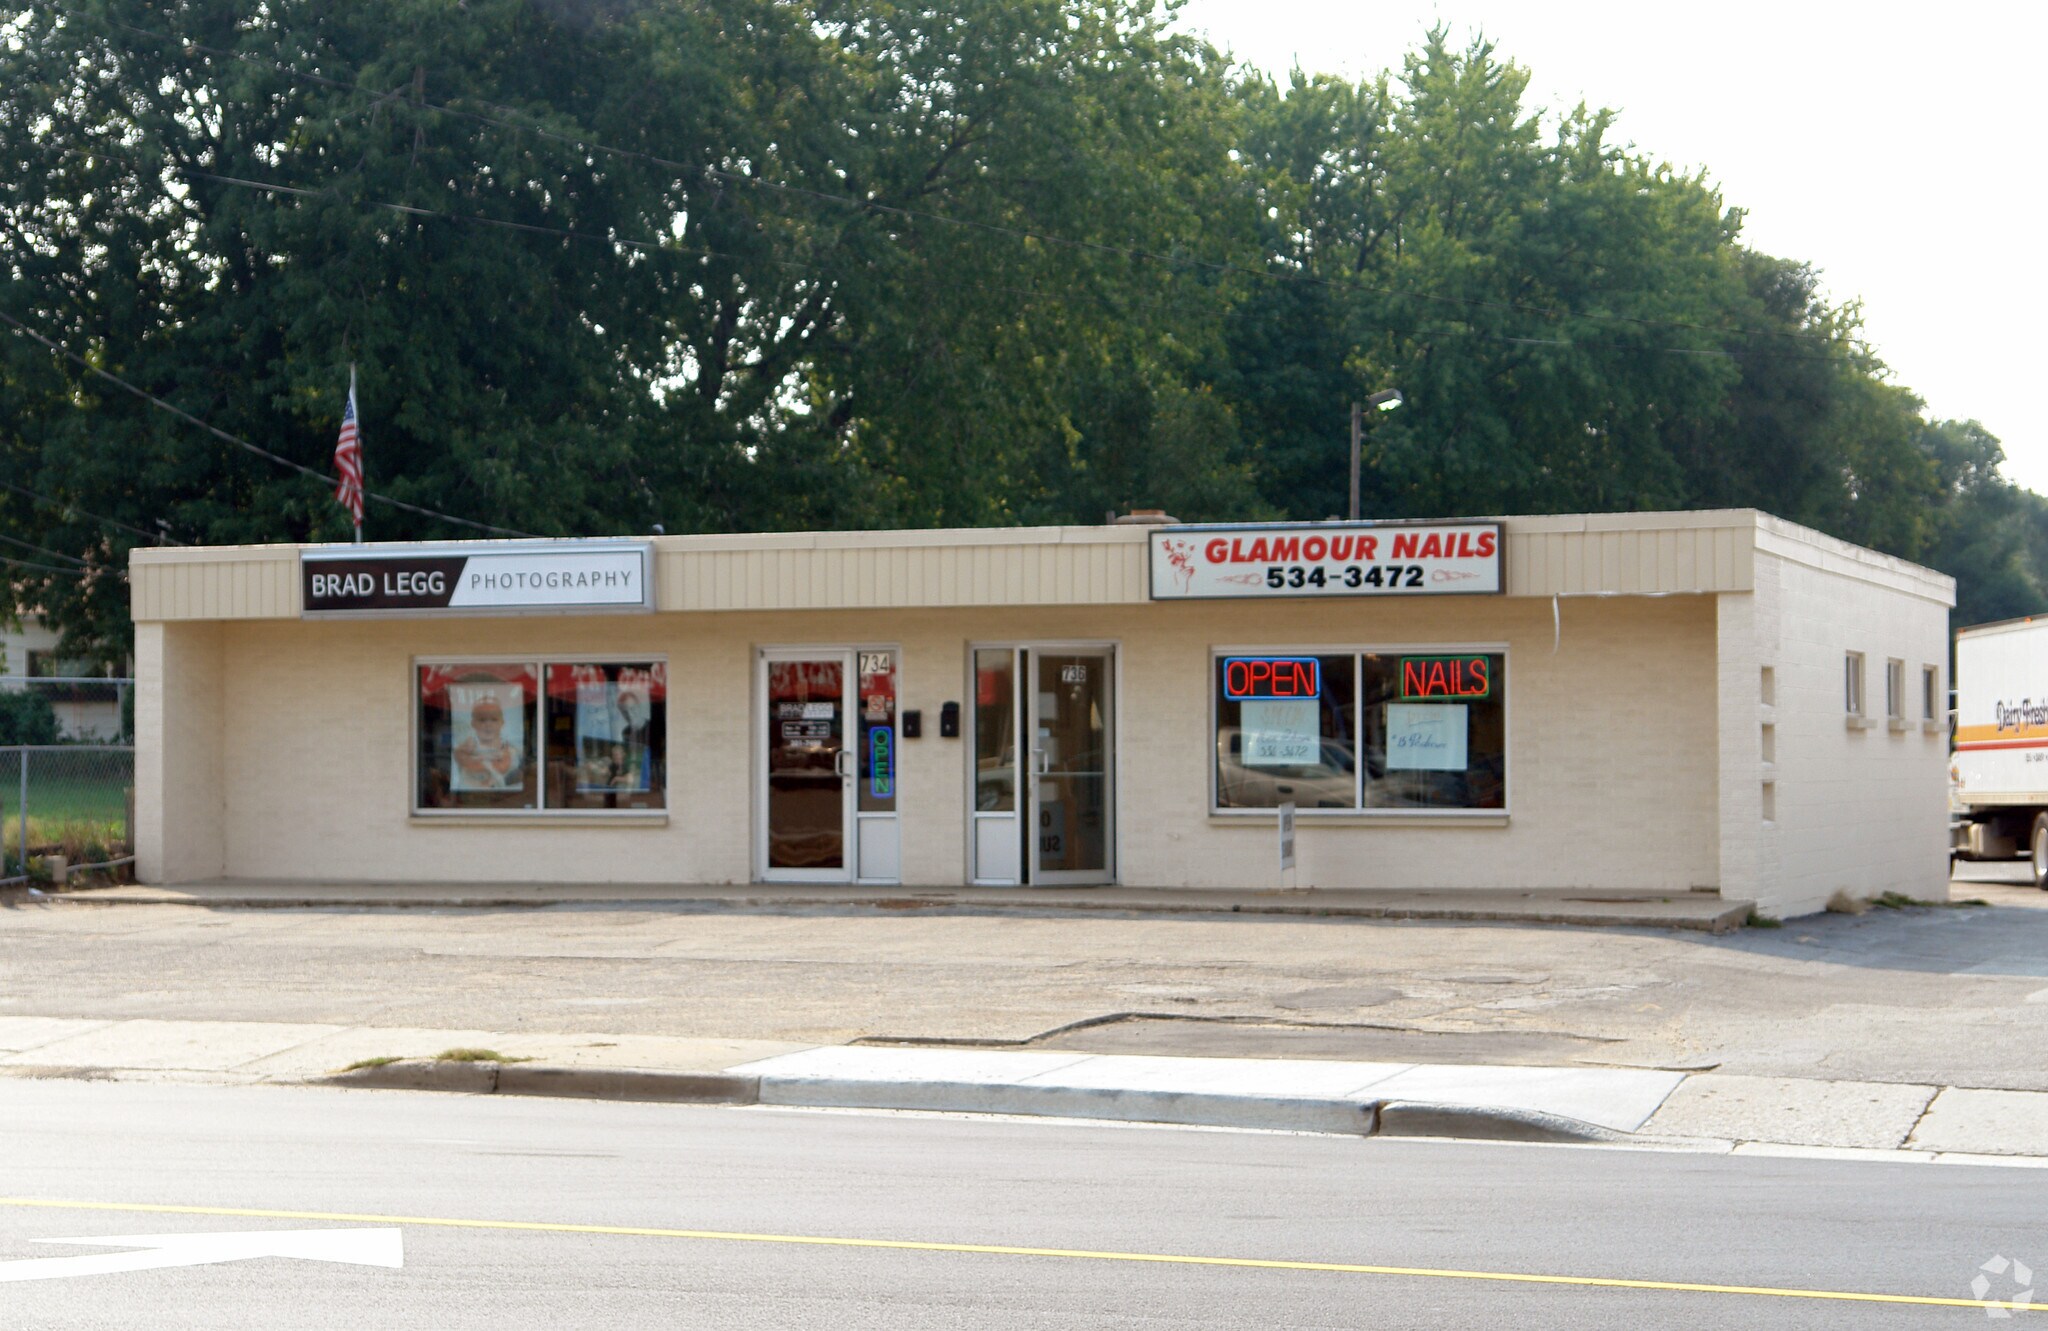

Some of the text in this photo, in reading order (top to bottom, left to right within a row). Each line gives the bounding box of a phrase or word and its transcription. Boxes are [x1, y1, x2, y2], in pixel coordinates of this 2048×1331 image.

[1204, 531, 1497, 565] GLAMOUR NAILS
[312, 570, 632, 597] BRAD LEGG PHOTOGRAPHY
[1266, 565, 1425, 589] 534-3472
[861, 654, 888, 672] 734
[1062, 665, 1086, 681] 736
[1404, 659, 1488, 697] NAILS
[1227, 661, 1316, 696] OPEN
[874, 730, 889, 793] OPEN
